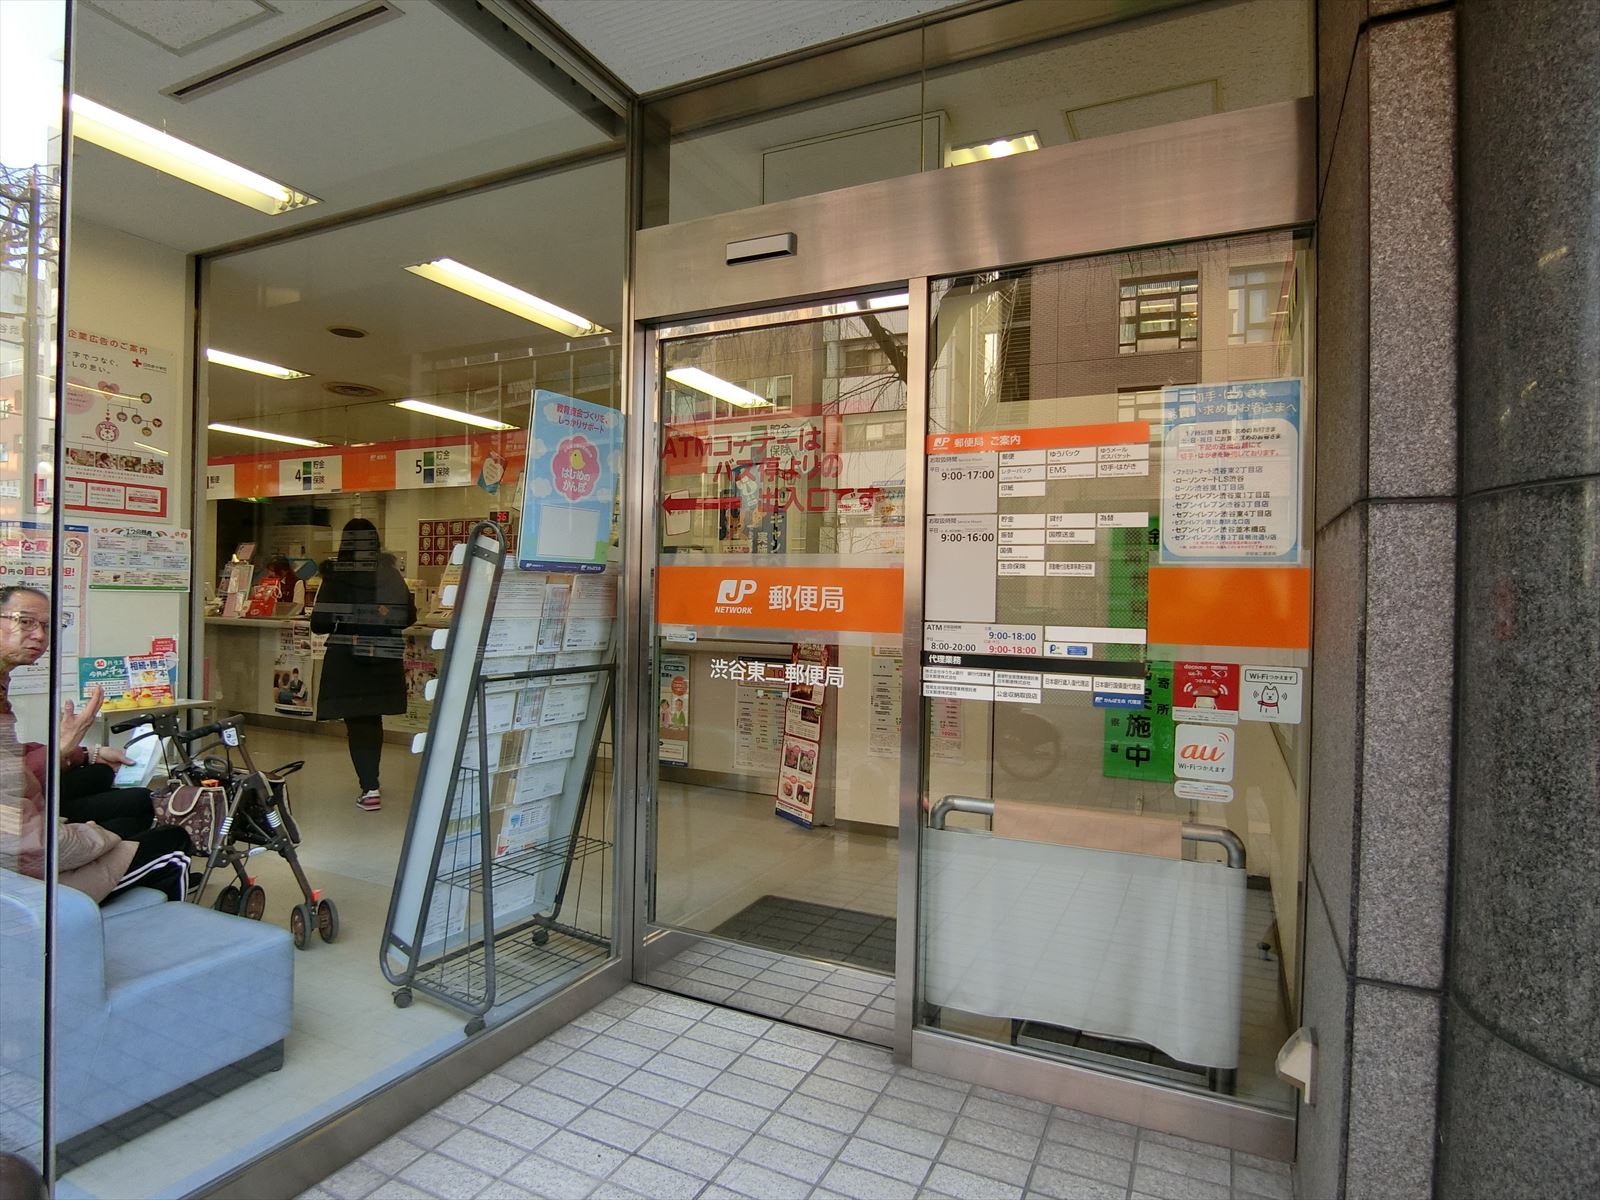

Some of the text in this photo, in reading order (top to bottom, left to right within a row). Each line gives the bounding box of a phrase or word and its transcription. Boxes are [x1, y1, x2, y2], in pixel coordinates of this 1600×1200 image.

[558, 416, 605, 433] しっかりサポート
[662, 427, 822, 459] ATMコーナーは
[954, 436, 984, 448] 郵便局
[991, 435, 1020, 446] ご案内
[1049, 450, 1080, 458] ゆうパック
[415, 459, 422, 474] 5
[713, 454, 843, 482] バス停よりの
[1049, 466, 1067, 474] EMS
[295, 469, 302, 482] 4
[561, 467, 591, 481] はじめの
[941, 470, 995, 481] 9:00-17:00
[562, 479, 587, 493] かんぽ
[757, 486, 882, 512] 出入口です
[941, 533, 995, 542] 9:00-16:00
[768, 585, 844, 613] 郵便局
[714, 606, 753, 614] NETWORK
[988, 631, 1037, 641] 9:00-18:00
[931, 642, 976, 652] 8:00-20:00
[988, 645, 1037, 655] 9:00-18:00
[929, 655, 961, 665] 代理業務
[710, 658, 845, 688] 渋谷東二郵便局
[1180, 744, 1225, 761] au
